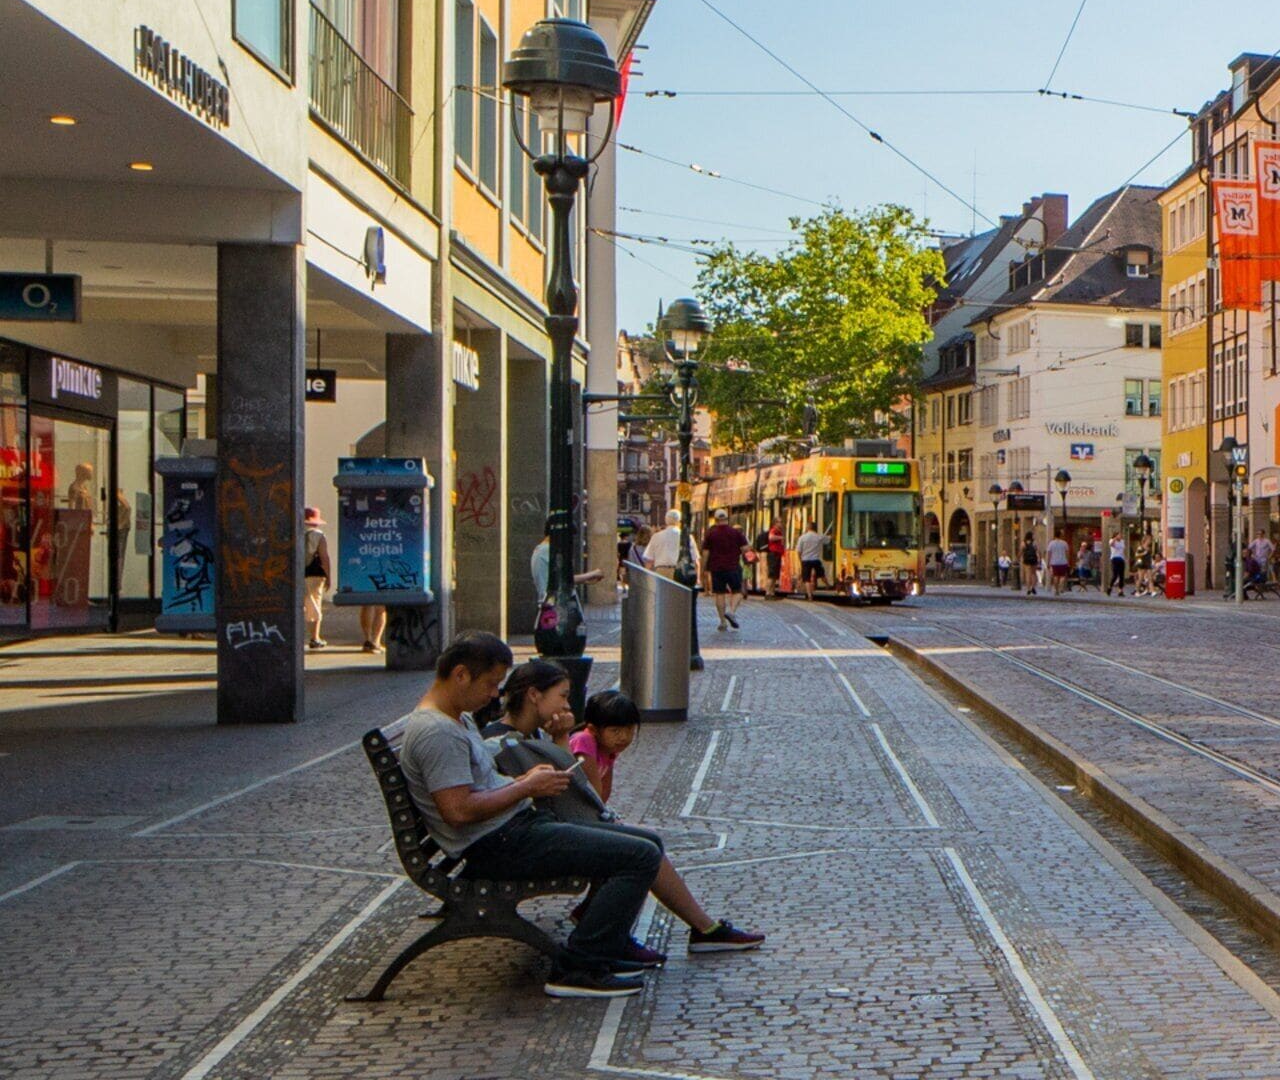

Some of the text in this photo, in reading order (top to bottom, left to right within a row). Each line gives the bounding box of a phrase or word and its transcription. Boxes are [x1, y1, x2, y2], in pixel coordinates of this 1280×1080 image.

[133, 24, 230, 128] HALLHUBER
[1230, 207, 1246, 222] M
[1045, 422, 1119, 437] Volksbank
[363, 517, 398, 529] Jetzt
[359, 530, 403, 542] wird's
[358, 543, 404, 557] digital
